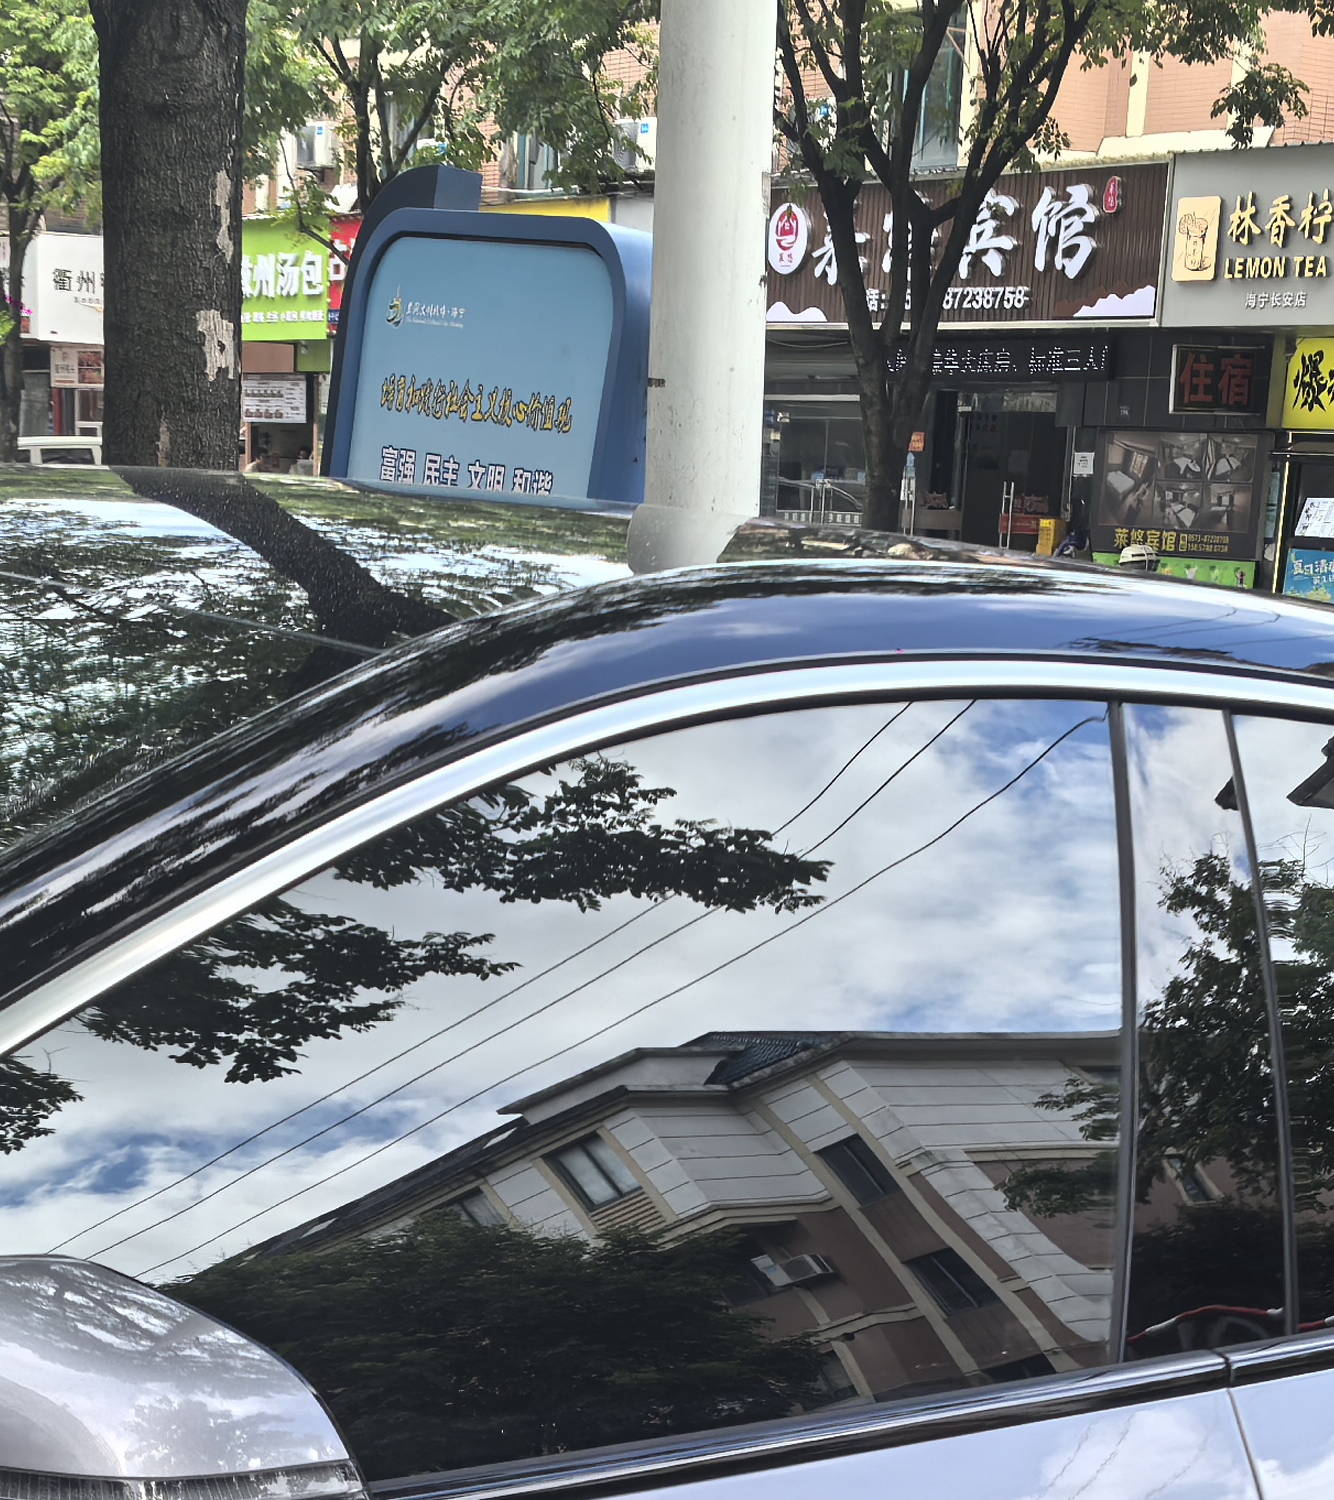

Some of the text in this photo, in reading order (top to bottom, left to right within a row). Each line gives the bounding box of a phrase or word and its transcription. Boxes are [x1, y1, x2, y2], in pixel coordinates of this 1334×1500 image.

[1227, 188, 1334, 248] 林香柠
[53, 268, 104, 294] 衢州
[1224, 255, 1327, 280] LEMON TEA
[1244, 291, 1307, 309] 海宁长安店
[380, 373, 573, 433] 培育和践行社会主义核心价值观
[1179, 353, 1253, 405] 住宿
[380, 445, 554, 496] 富强 民主 文明 和谐
